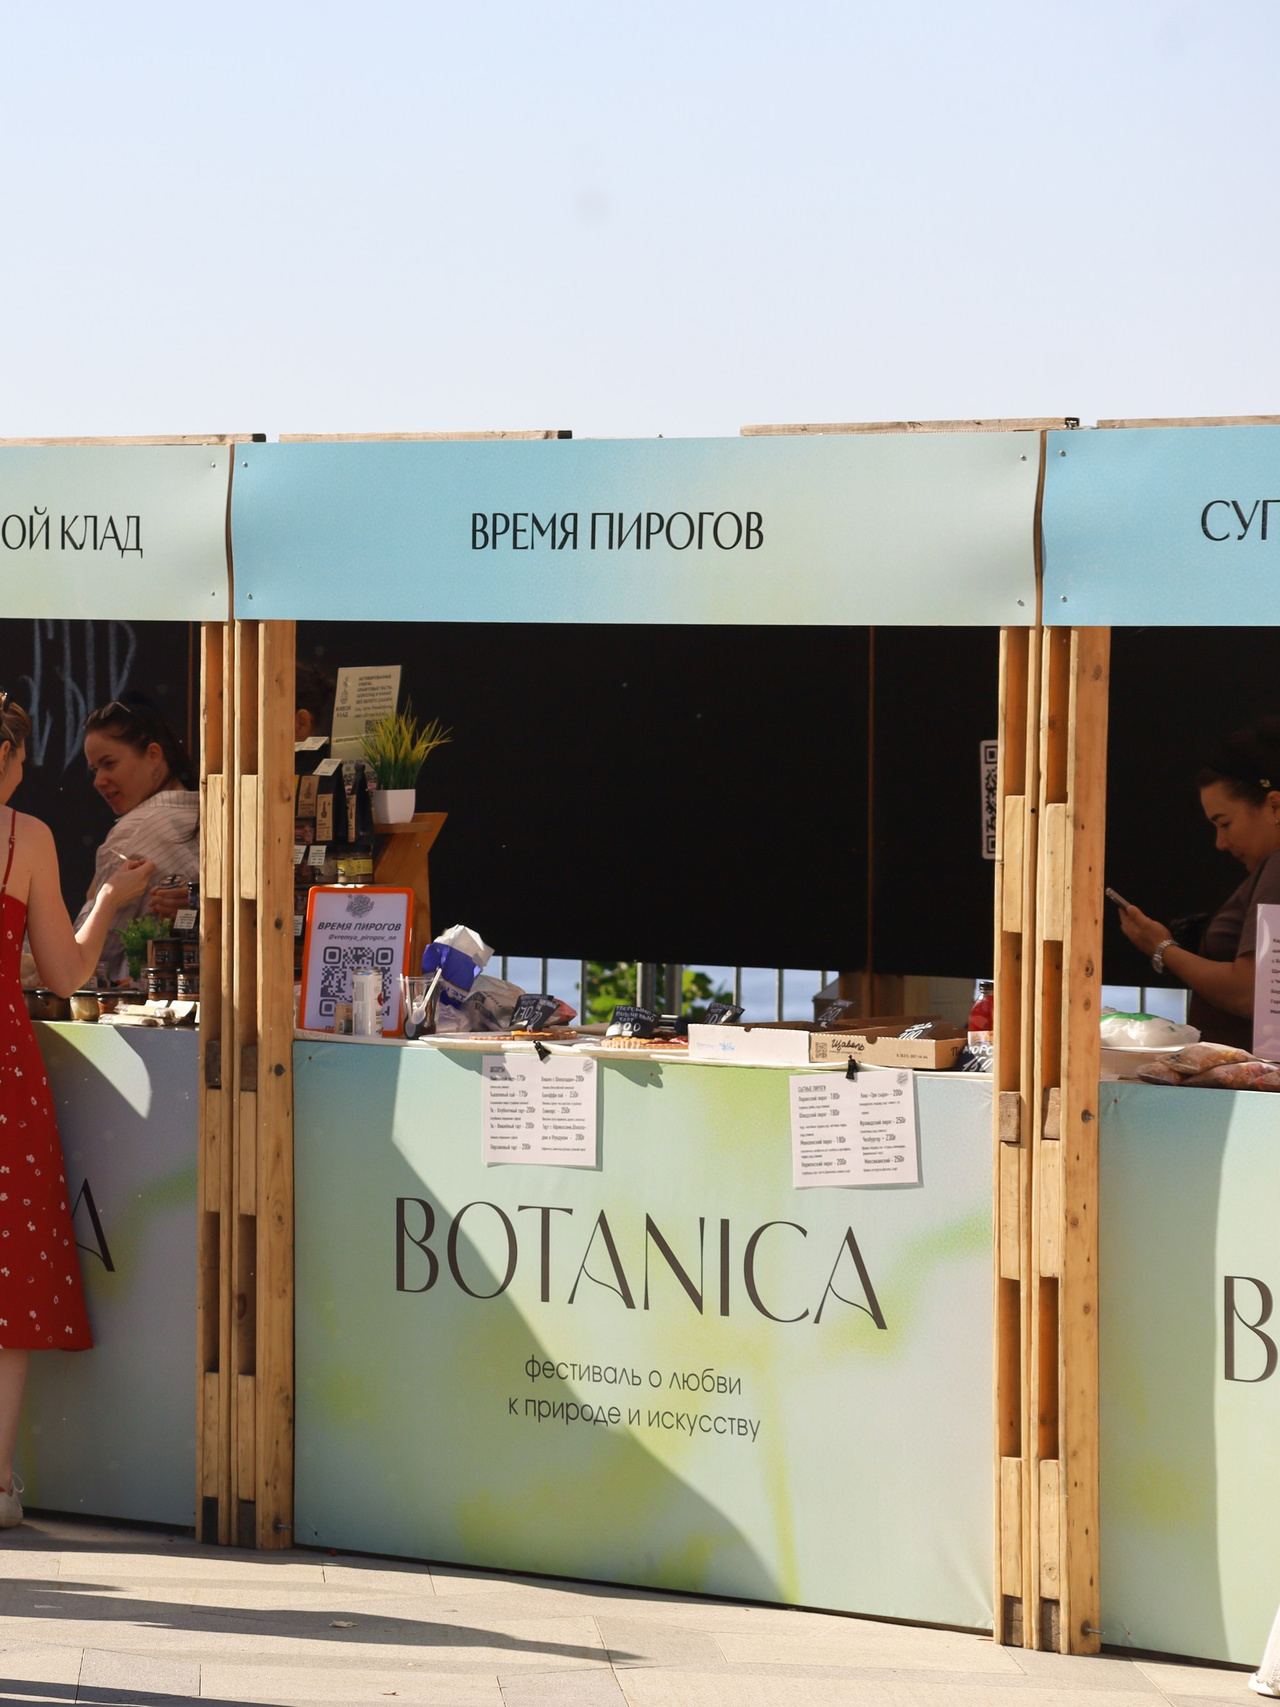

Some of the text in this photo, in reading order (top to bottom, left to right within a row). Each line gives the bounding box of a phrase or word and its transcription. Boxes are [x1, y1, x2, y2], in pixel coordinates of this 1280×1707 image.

[60, 514, 144, 559] КЛАД
[472, 511, 764, 551] ВРЕМЯ ПИРОГОВ
[317, 921, 402, 931] ВРЕМЯ ПИРОГОВ
[328, 933, 397, 942] @vremya_pirogov_nn
[962, 1044, 994, 1056] МОРС
[396, 1197, 888, 1330] BOTANICA
[525, 1354, 742, 1396] фестиваль о любви
[508, 1397, 761, 1443] к природе и искусству
